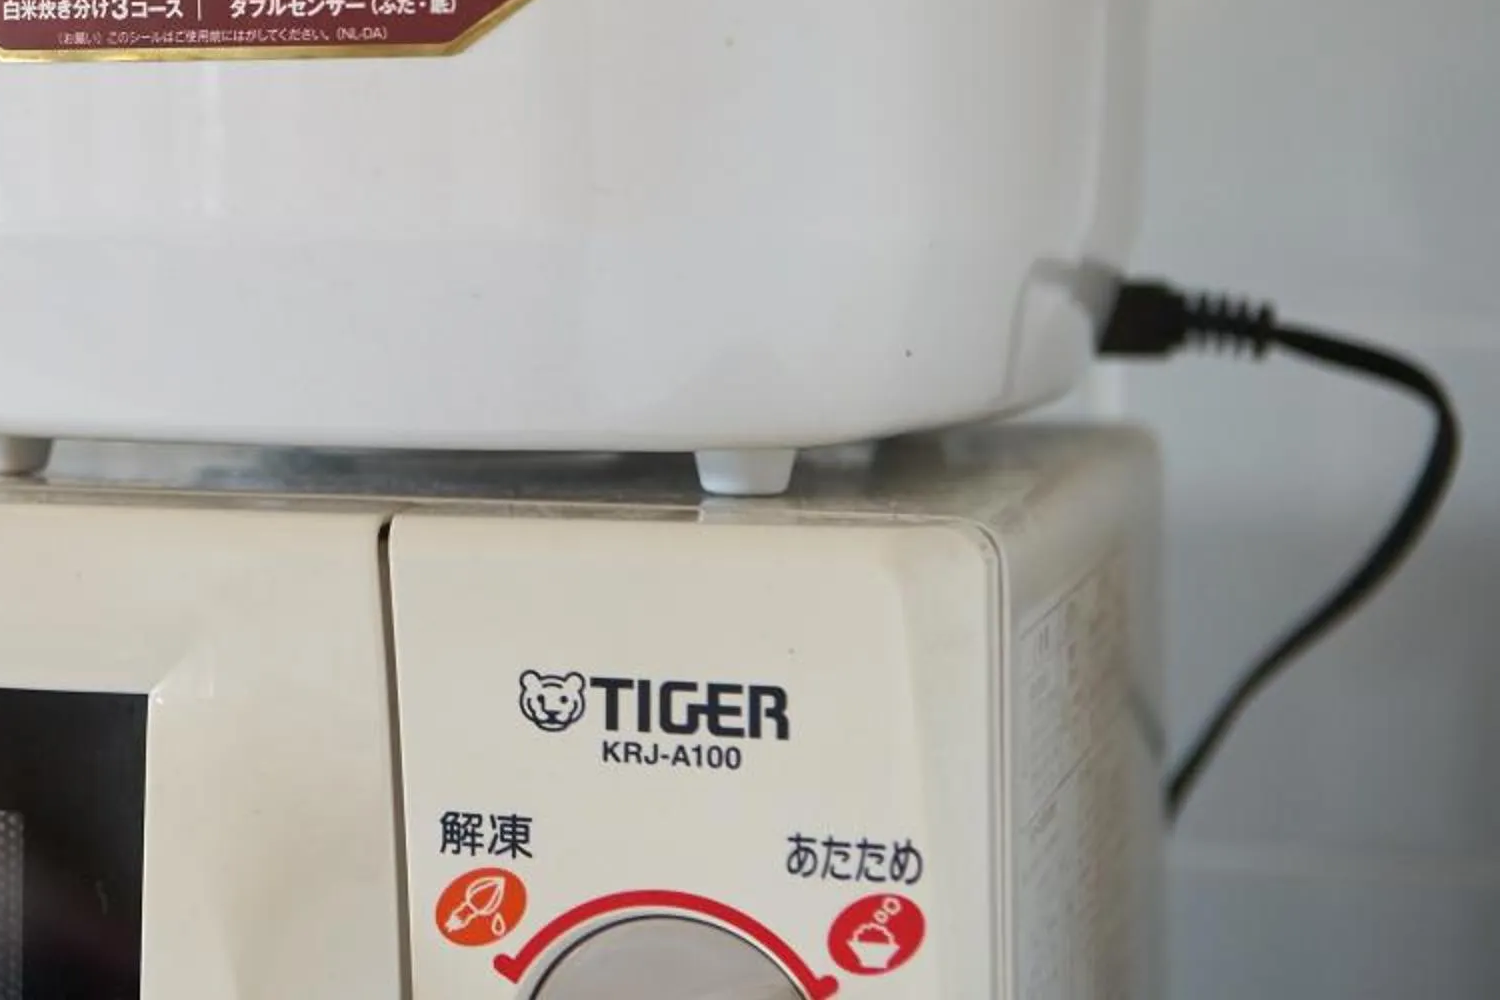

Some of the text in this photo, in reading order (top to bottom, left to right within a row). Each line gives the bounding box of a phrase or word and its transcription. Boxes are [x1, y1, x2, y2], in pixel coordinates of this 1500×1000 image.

[589, 676, 790, 740] TIGER
[601, 741, 743, 770] KRJ-A100
[439, 811, 533, 859] 解凍
[786, 832, 923, 885] あたため
